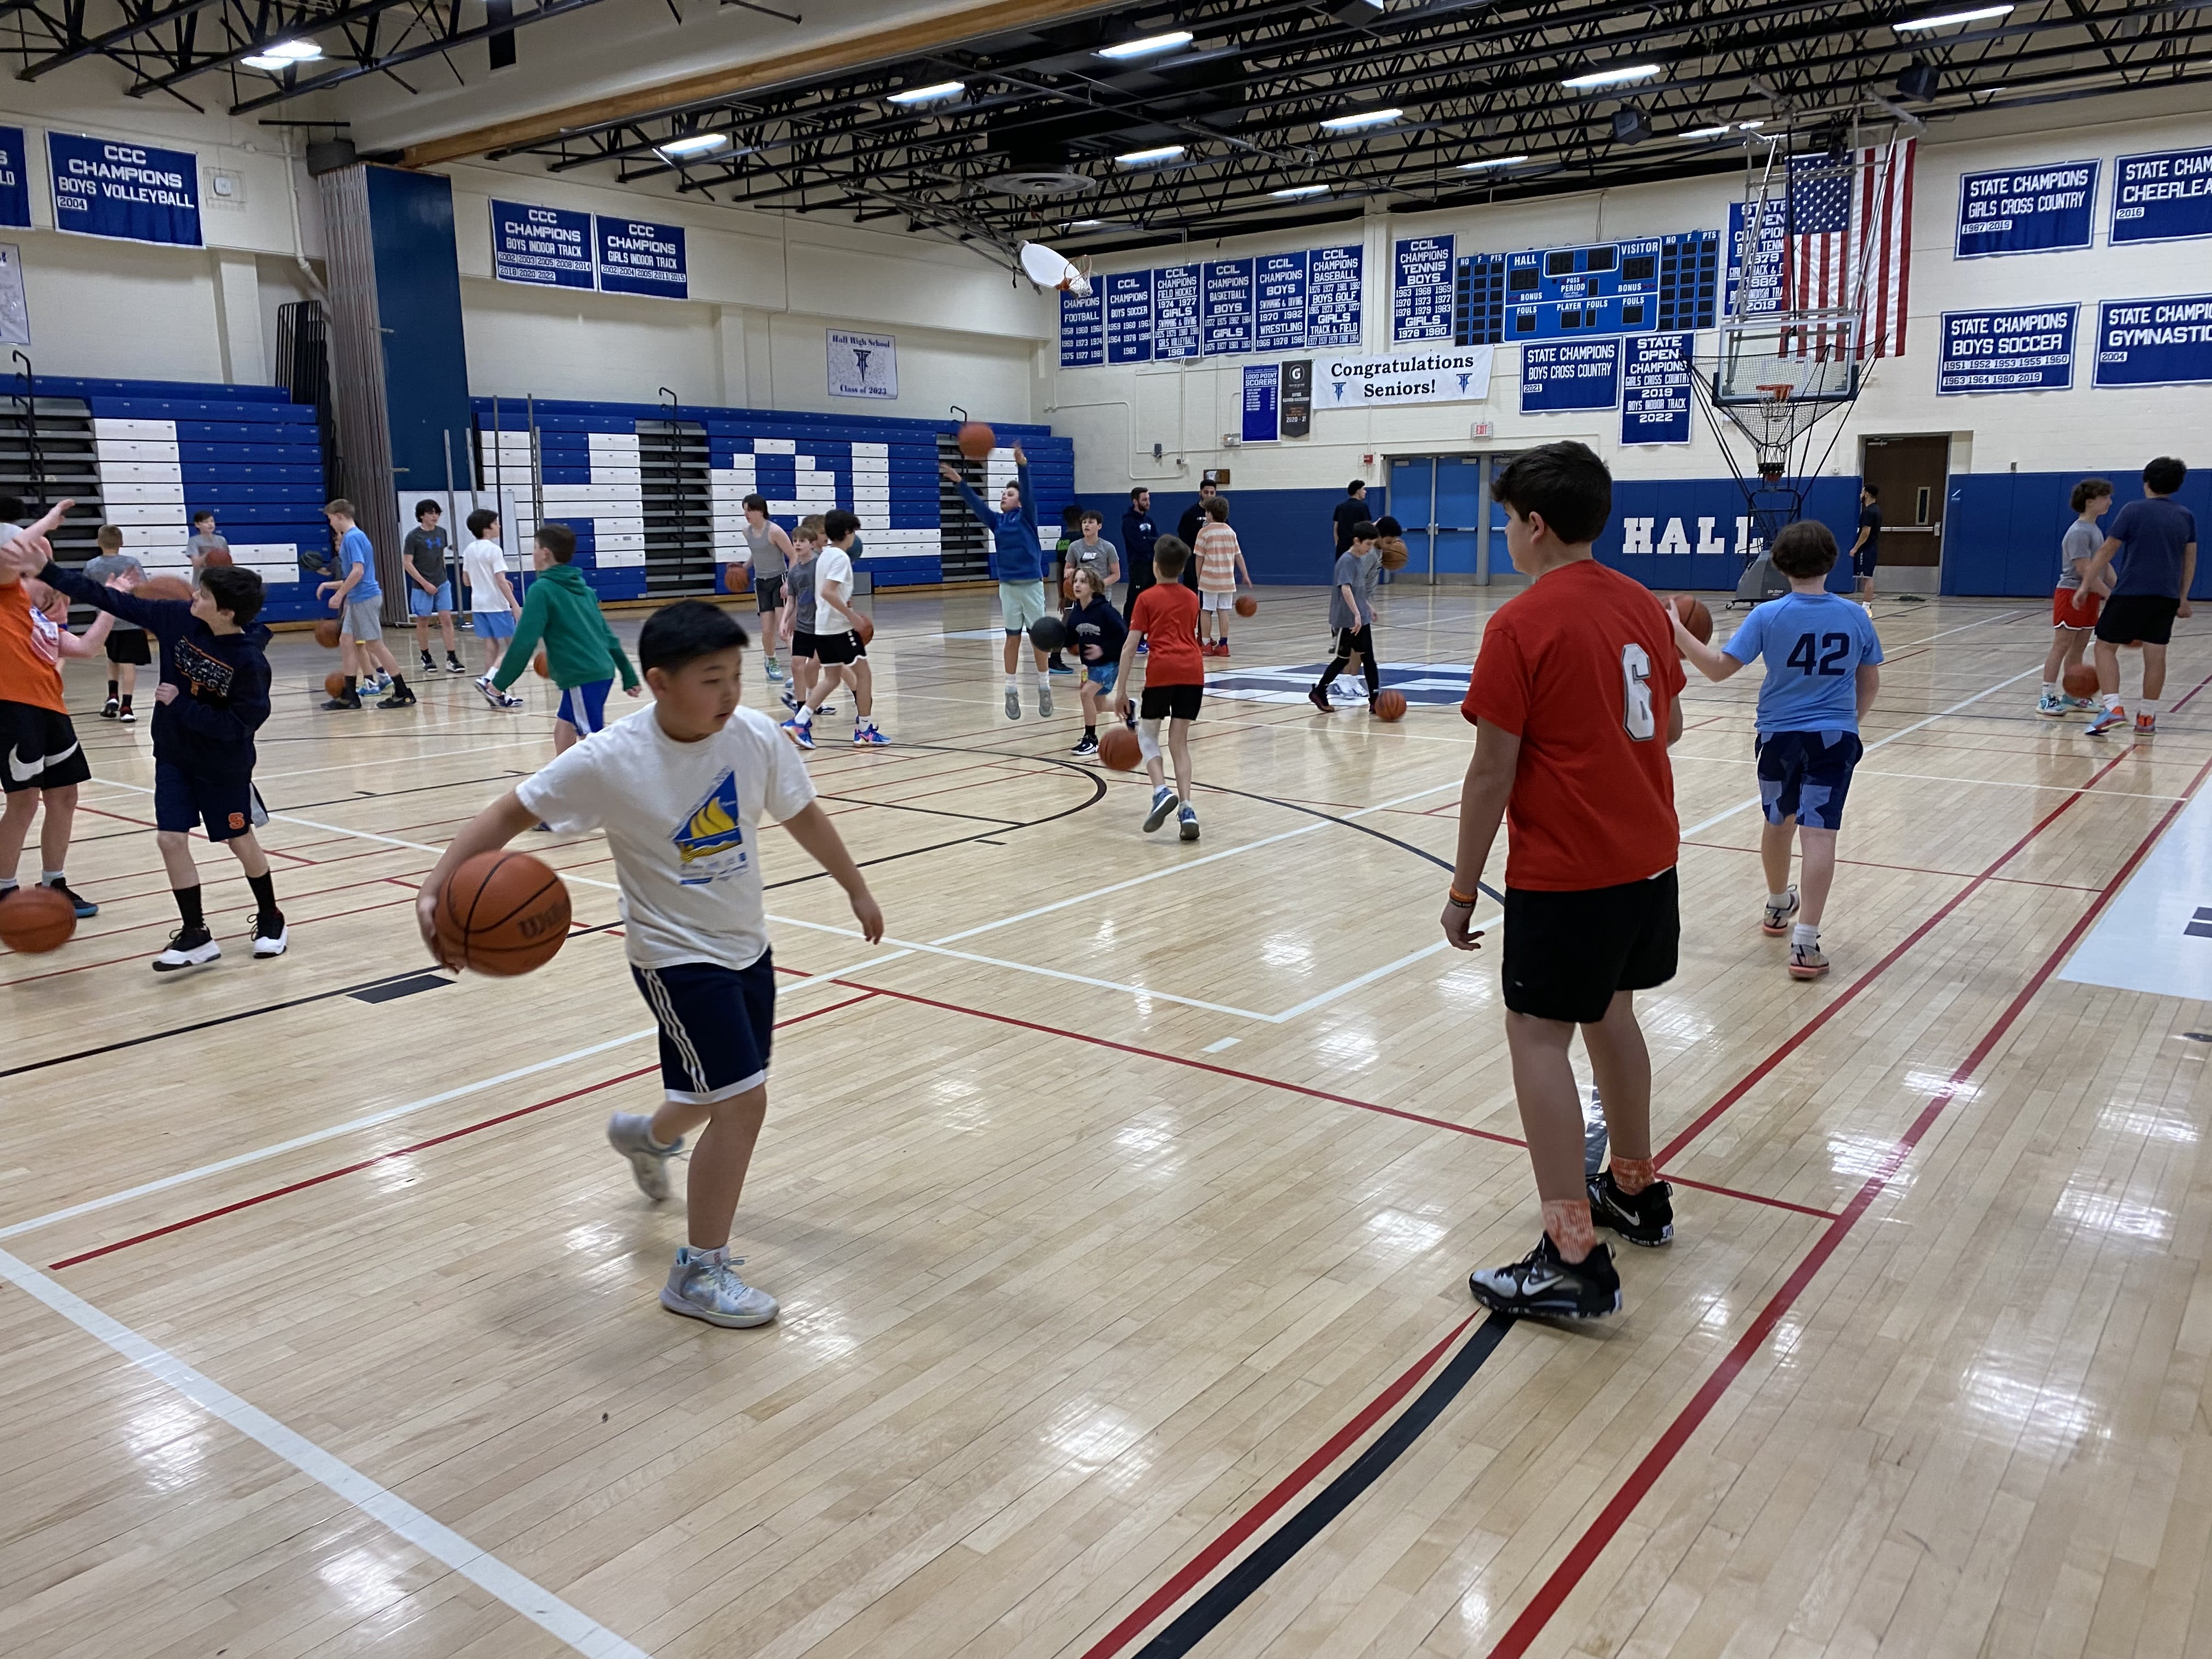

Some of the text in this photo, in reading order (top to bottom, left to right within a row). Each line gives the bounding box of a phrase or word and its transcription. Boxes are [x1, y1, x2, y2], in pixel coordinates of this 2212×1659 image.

[104, 145, 146, 165] CCC
[69, 159, 182, 188] CHAMPIONS
[2126, 156, 2212, 180] STATE CHAM
[1970, 170, 2089, 198] STATE CHAMPIONS
[58, 177, 194, 208] BOYS VOLLEYBALL
[2124, 181, 2212, 202] CHEERLEA
[59, 197, 85, 208] 2004
[1968, 191, 2085, 218] GIRLS CROSS COUNTRY
[528, 210, 557, 223] CCC
[2118, 208, 2142, 218] 2016
[505, 222, 580, 242] CHAMPIONS
[629, 224, 654, 237] CCC
[1963, 221, 2010, 233] 1987 2019
[1666, 231, 1717, 244] NO F PTS
[506, 238, 582, 257] BOYS INDOOR TRACK
[607, 235, 675, 255] CHAMPIONS
[1410, 240, 1438, 251] CCIL
[1621, 242, 1658, 255] VISITOR
[608, 251, 677, 269] GIRLS INDOOR TRACK
[1323, 249, 1348, 259] CCIL
[1400, 249, 1448, 263] CHAMPIONS
[1514, 255, 1536, 266] HALL
[499, 253, 590, 270] 2002 2003 2005 2008 2014
[1268, 258, 1294, 269] CCIL
[1313, 258, 1358, 272] CHAMPIONS
[1402, 261, 1446, 274] TENNIS
[500, 267, 554, 280] 2018 2020 2022
[602, 265, 617, 273] 2002
[619, 267, 634, 275] 2004
[637, 269, 652, 278] 2005
[654, 272, 669, 280] 2011
[1165, 268, 1188, 278] CCIL
[1216, 264, 1240, 275] CCIL
[1314, 270, 1356, 282] BASEBALL
[1118, 278, 1139, 289] CCIL
[1158, 276, 1197, 289] CHAMPIONS
[1208, 276, 1249, 289] CHAMPIONS
[1260, 270, 1303, 284] CHAMPIONS
[1407, 273, 1441, 285] BOYS
[1158, 286, 1197, 299] FIELD HOCKEY
[1266, 284, 1295, 296] BOYS
[1396, 285, 1452, 298] 1963 1968 1969
[1561, 283, 1585, 292] PERIOD
[1618, 283, 1641, 292] BONUS
[1110, 291, 1148, 303] CHAMPIONS
[1210, 289, 1247, 301] BASKETBALL
[1312, 291, 1357, 303] BOYS GOLF
[1395, 295, 1451, 307] 1970 1973 1977
[1520, 292, 1543, 301] BONUS
[1623, 296, 1645, 305] FOULS
[1064, 297, 1099, 308] CHAMPIONS
[1214, 303, 1242, 314] BOYS
[1556, 299, 1608, 311] PLAYER FOULS
[1111, 306, 1148, 318] BOYS SOCCER
[1163, 307, 1192, 318] GIRLS
[1260, 310, 1302, 322] 1970 1982
[1395, 304, 1451, 317] 1978 1979 1983
[1516, 306, 1537, 314] FOULS
[2109, 307, 2152, 326] STATE
[1064, 311, 1099, 323] FOOTBALL
[1318, 313, 1351, 324] GIRLS
[1405, 314, 1441, 327] GIRLS
[1260, 322, 1302, 334] WRESTLING
[1310, 325, 1330, 335] TRACK
[1339, 323, 1358, 333] FIELD
[1951, 312, 2067, 336] STATE CHAMPIONS
[1213, 328, 1243, 338] GIRLS
[1398, 326, 1447, 338] 1978 1980
[850, 337, 866, 346] High
[868, 339, 889, 347] School
[1637, 336, 1683, 349] STATE
[1952, 334, 2062, 356] BOYS SOCCER
[1528, 344, 1615, 363] STATE CHAMPIONS
[1639, 348, 1680, 362] OPEN
[2102, 352, 2125, 362] 2004
[1331, 355, 1474, 379] Congratulations
[1630, 360, 1687, 375] CHAMPIONS
[1945, 355, 2067, 370] 1951 1952 1953 1955 1960
[1292, 368, 1301, 380] G
[1528, 362, 1612, 380] BOYS CROSS COUNTRY
[1245, 378, 1277, 386] SCORERS
[1625, 374, 1663, 387] GIRLS CROSS
[1944, 372, 2040, 386] 1963 1964 1980 2019
[1364, 379, 1436, 398] Seniors!
[1641, 388, 1673, 398] 2019
[1639, 413, 1673, 424] 2022
[1622, 516, 1764, 554] HALL
[1787, 633, 1850, 675] 42
[1621, 643, 1655, 742] 6
[228, 812, 245, 830] S
